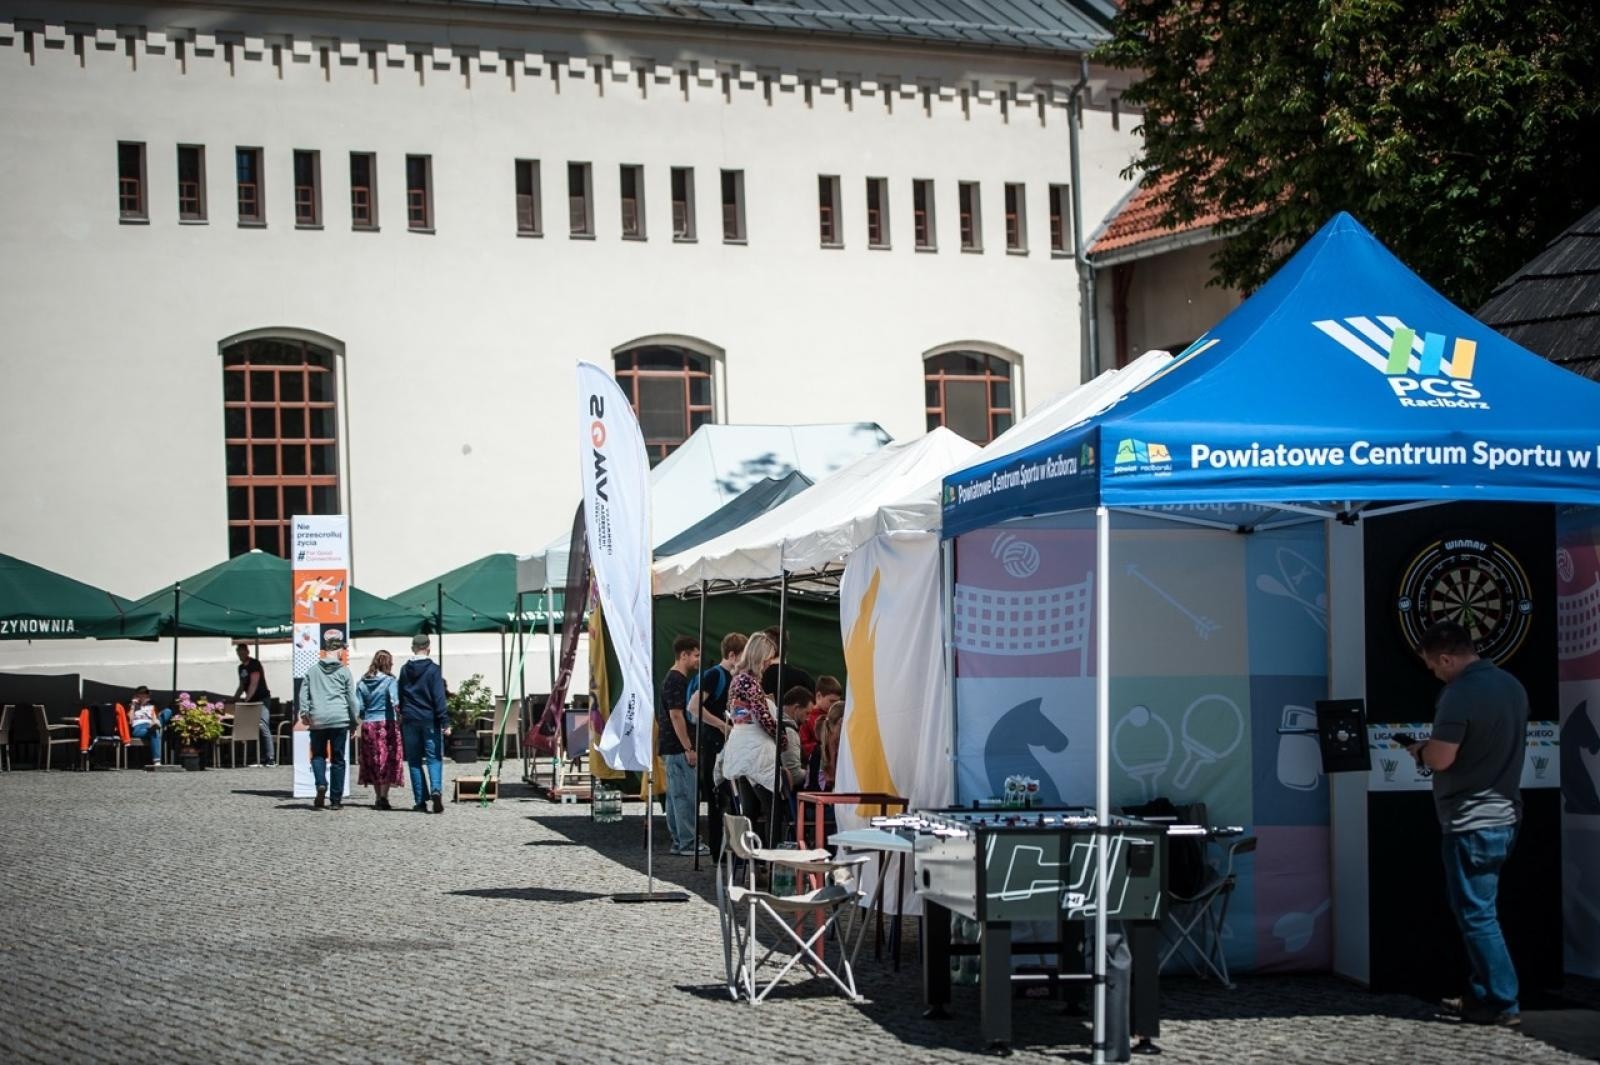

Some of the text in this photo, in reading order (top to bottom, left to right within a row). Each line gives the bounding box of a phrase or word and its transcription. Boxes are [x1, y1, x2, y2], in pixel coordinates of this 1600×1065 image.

[1387, 377, 1481, 399] PCS
[1399, 397, 1490, 410] Racibórz
[1191, 442, 1344, 469] Powiatowe
[1349, 440, 1467, 466] Centrum
[1472, 440, 1562, 470] Sportu
[1567, 450, 1592, 468] w
[958, 454, 1078, 504] Powiatowe Centrum Sportu w Raciborzu
[1444, 539, 1488, 551] WINMAU
[0, 619, 75, 634] ZYNOWNIA
